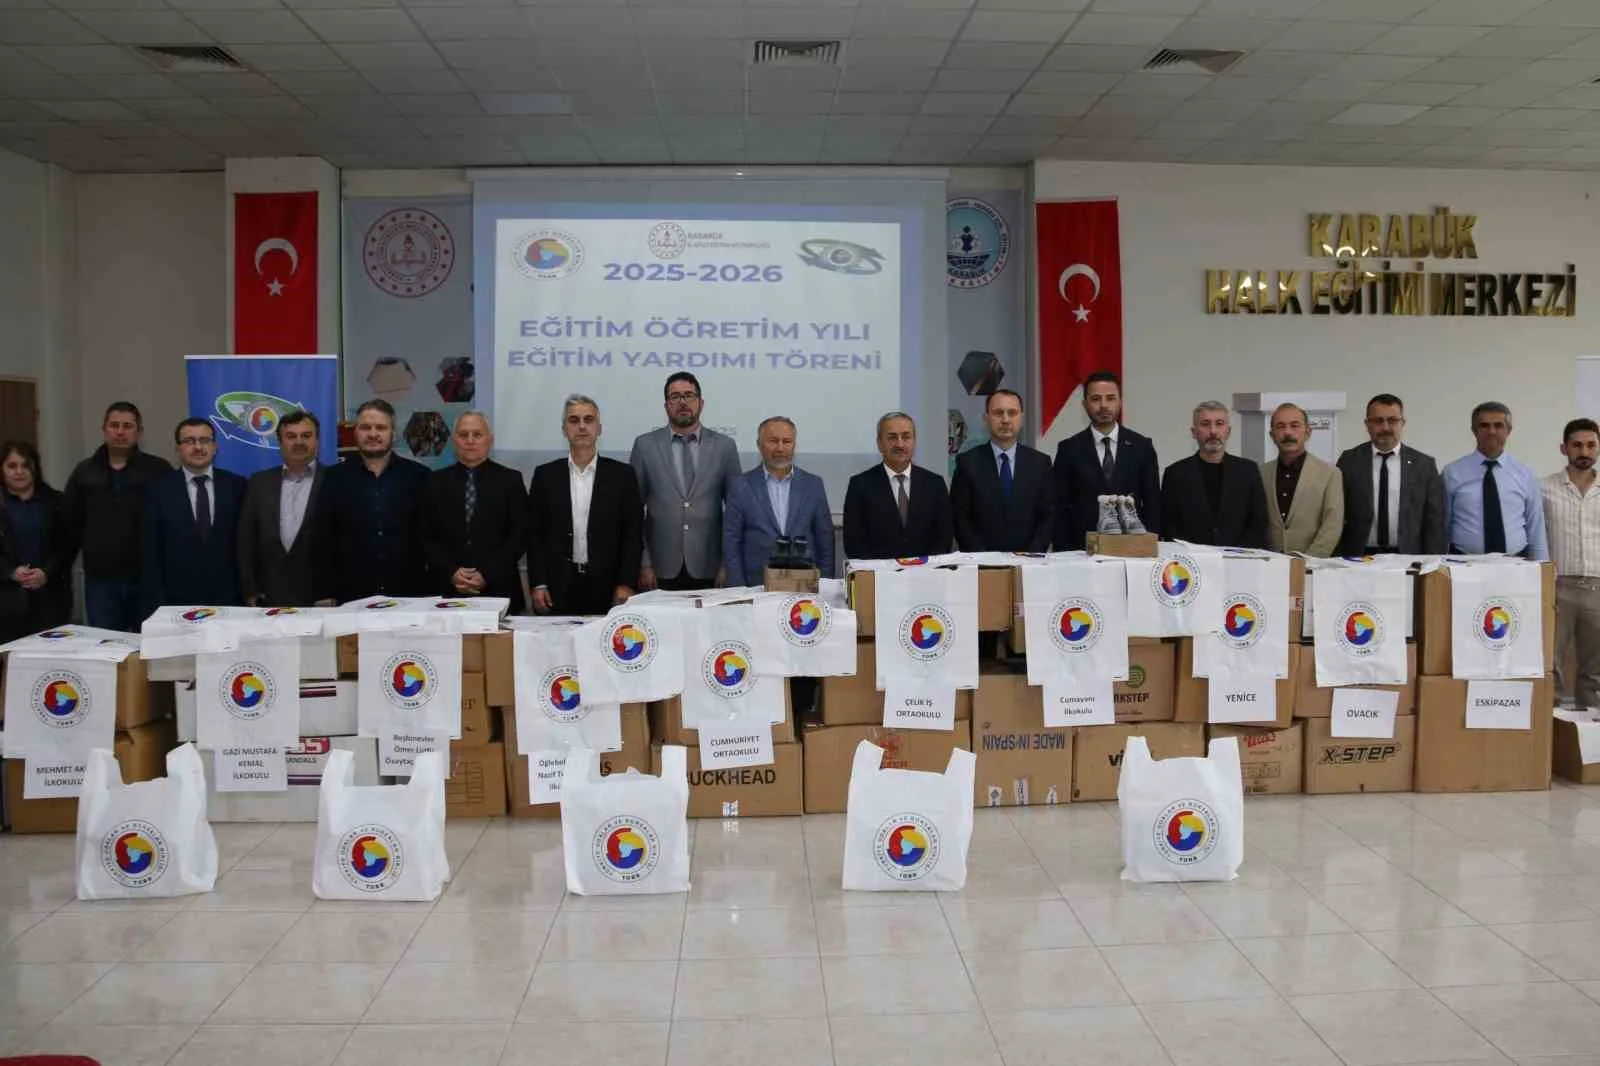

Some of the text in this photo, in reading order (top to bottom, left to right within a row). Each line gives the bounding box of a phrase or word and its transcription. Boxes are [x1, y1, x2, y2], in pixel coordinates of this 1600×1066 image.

[1307, 207, 1478, 258] KARABÜK
[603, 263, 783, 283] 2025-2026
[1205, 269, 1303, 314] HALK
[1430, 263, 1576, 316] MERKEZİ
[519, 316, 871, 341] EĞİTİM ÖĞRETİM YILI
[507, 347, 882, 370] EĞİTİM YARDIMI TÖRENİ
[1225, 692, 1257, 702] YENİCE
[710, 735, 761, 747] CUMHURİYET
[713, 748, 760, 759] ORTAOKULU
[687, 768, 776, 786] UCKHEAD
